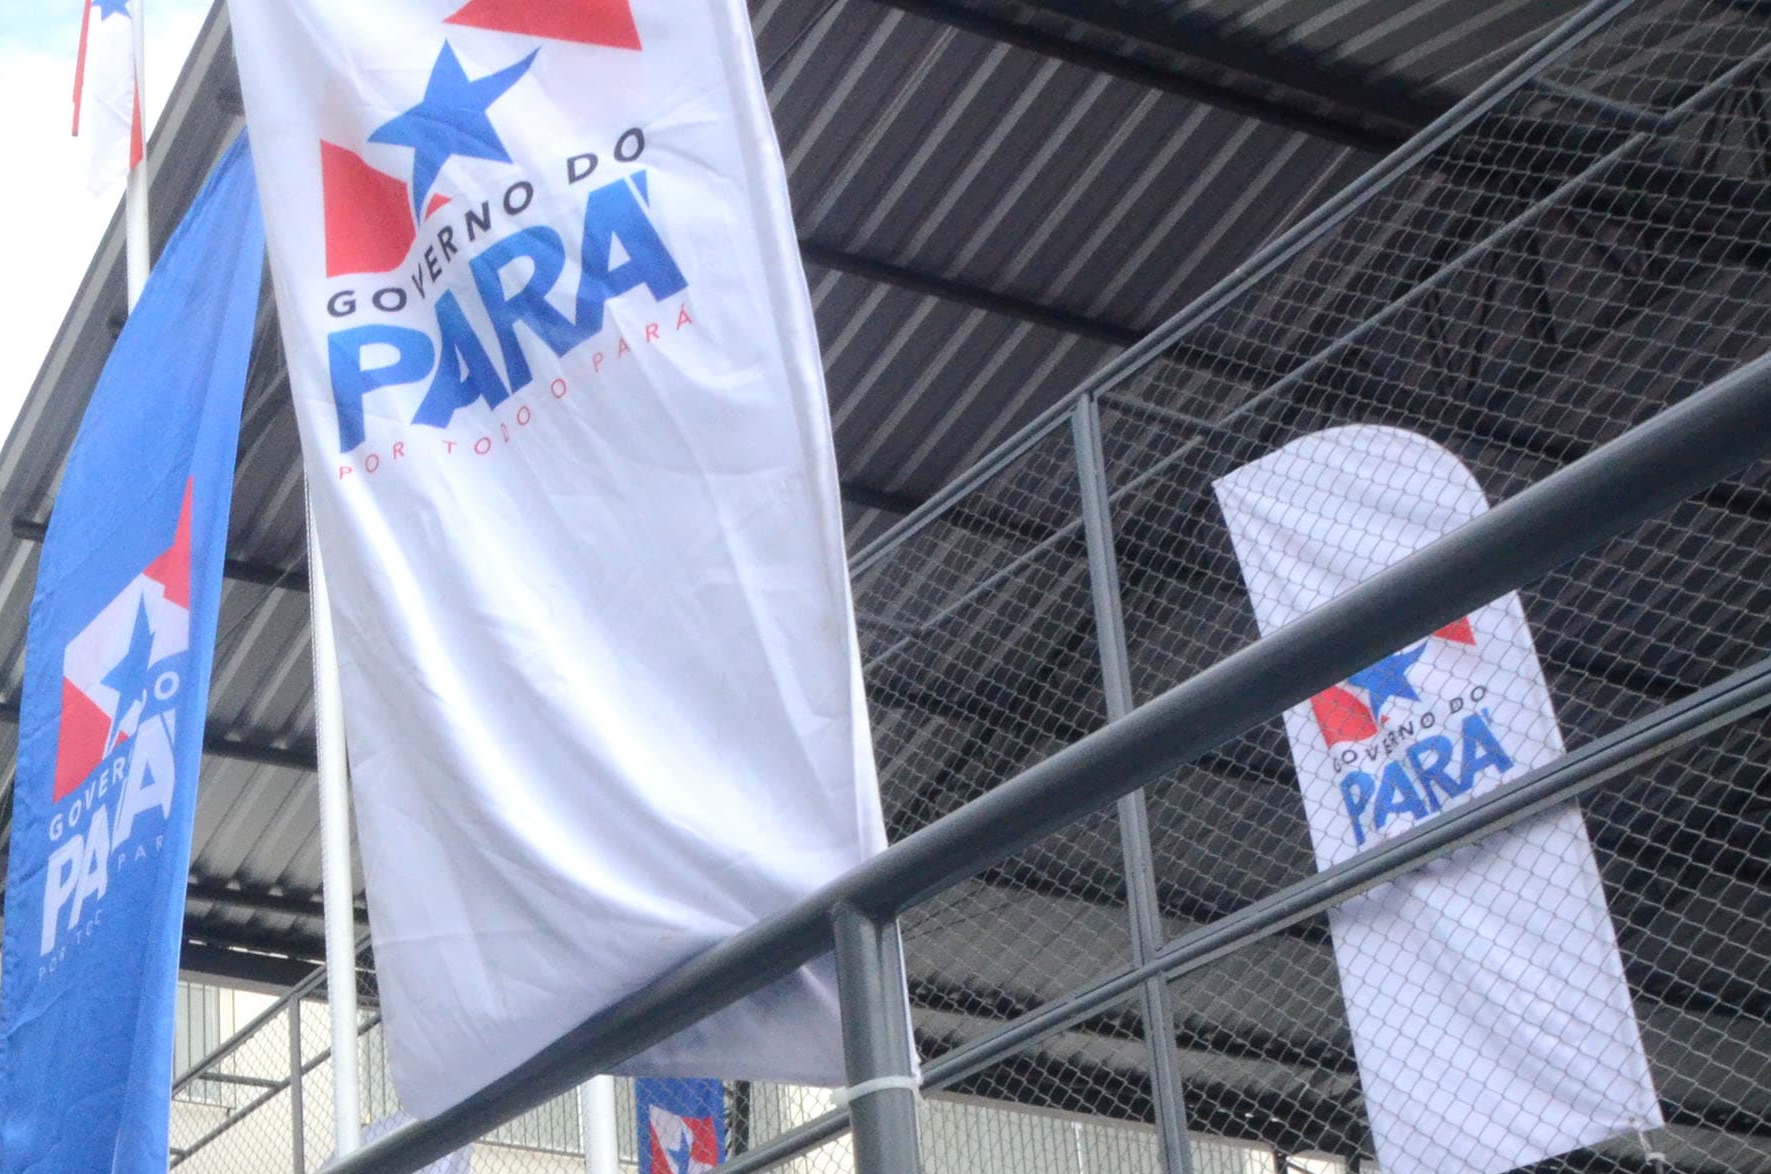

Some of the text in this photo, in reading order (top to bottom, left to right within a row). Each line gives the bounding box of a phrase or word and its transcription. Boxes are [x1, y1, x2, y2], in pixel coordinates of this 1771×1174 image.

[328, 127, 646, 318] GOVERNO DO
[328, 169, 688, 454] PARÁ
[339, 442, 405, 479] POR
[550, 378, 567, 399] O
[593, 303, 693, 373] PARÁ
[49, 757, 126, 841] GOVER
[1333, 685, 1486, 774] GOVERNO DO
[1340, 707, 1514, 846] PARÁ
[41, 708, 177, 957] PAÁ
[118, 834, 164, 871] PAR
